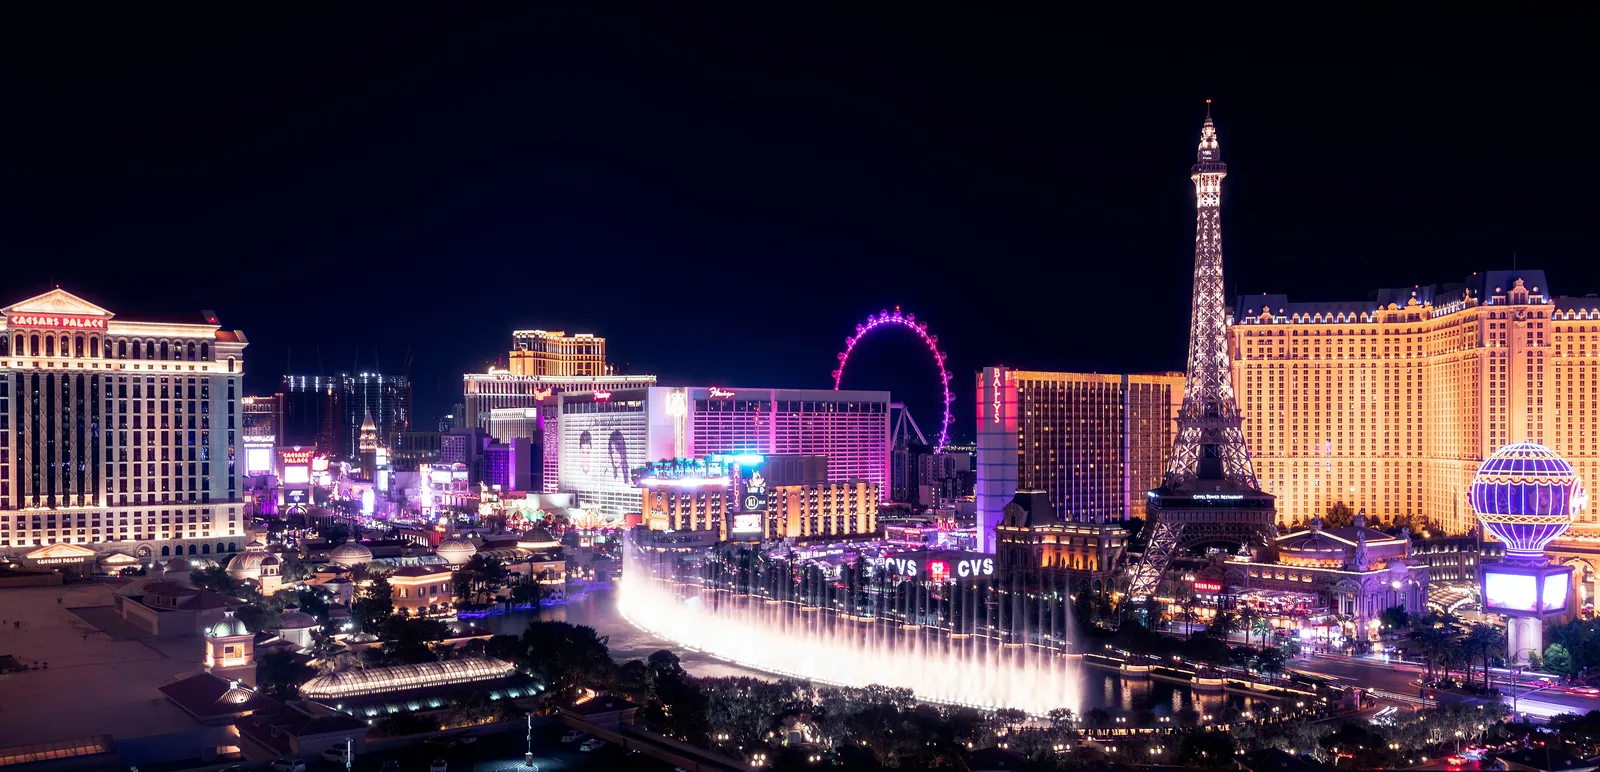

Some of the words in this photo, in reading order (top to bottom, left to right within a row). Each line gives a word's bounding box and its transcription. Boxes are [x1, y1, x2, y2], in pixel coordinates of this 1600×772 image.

[11, 315, 60, 326] CAESARS
[63, 317, 104, 328] PALACE
[885, 557, 917, 577] CVS
[957, 557, 994, 578] CVS
